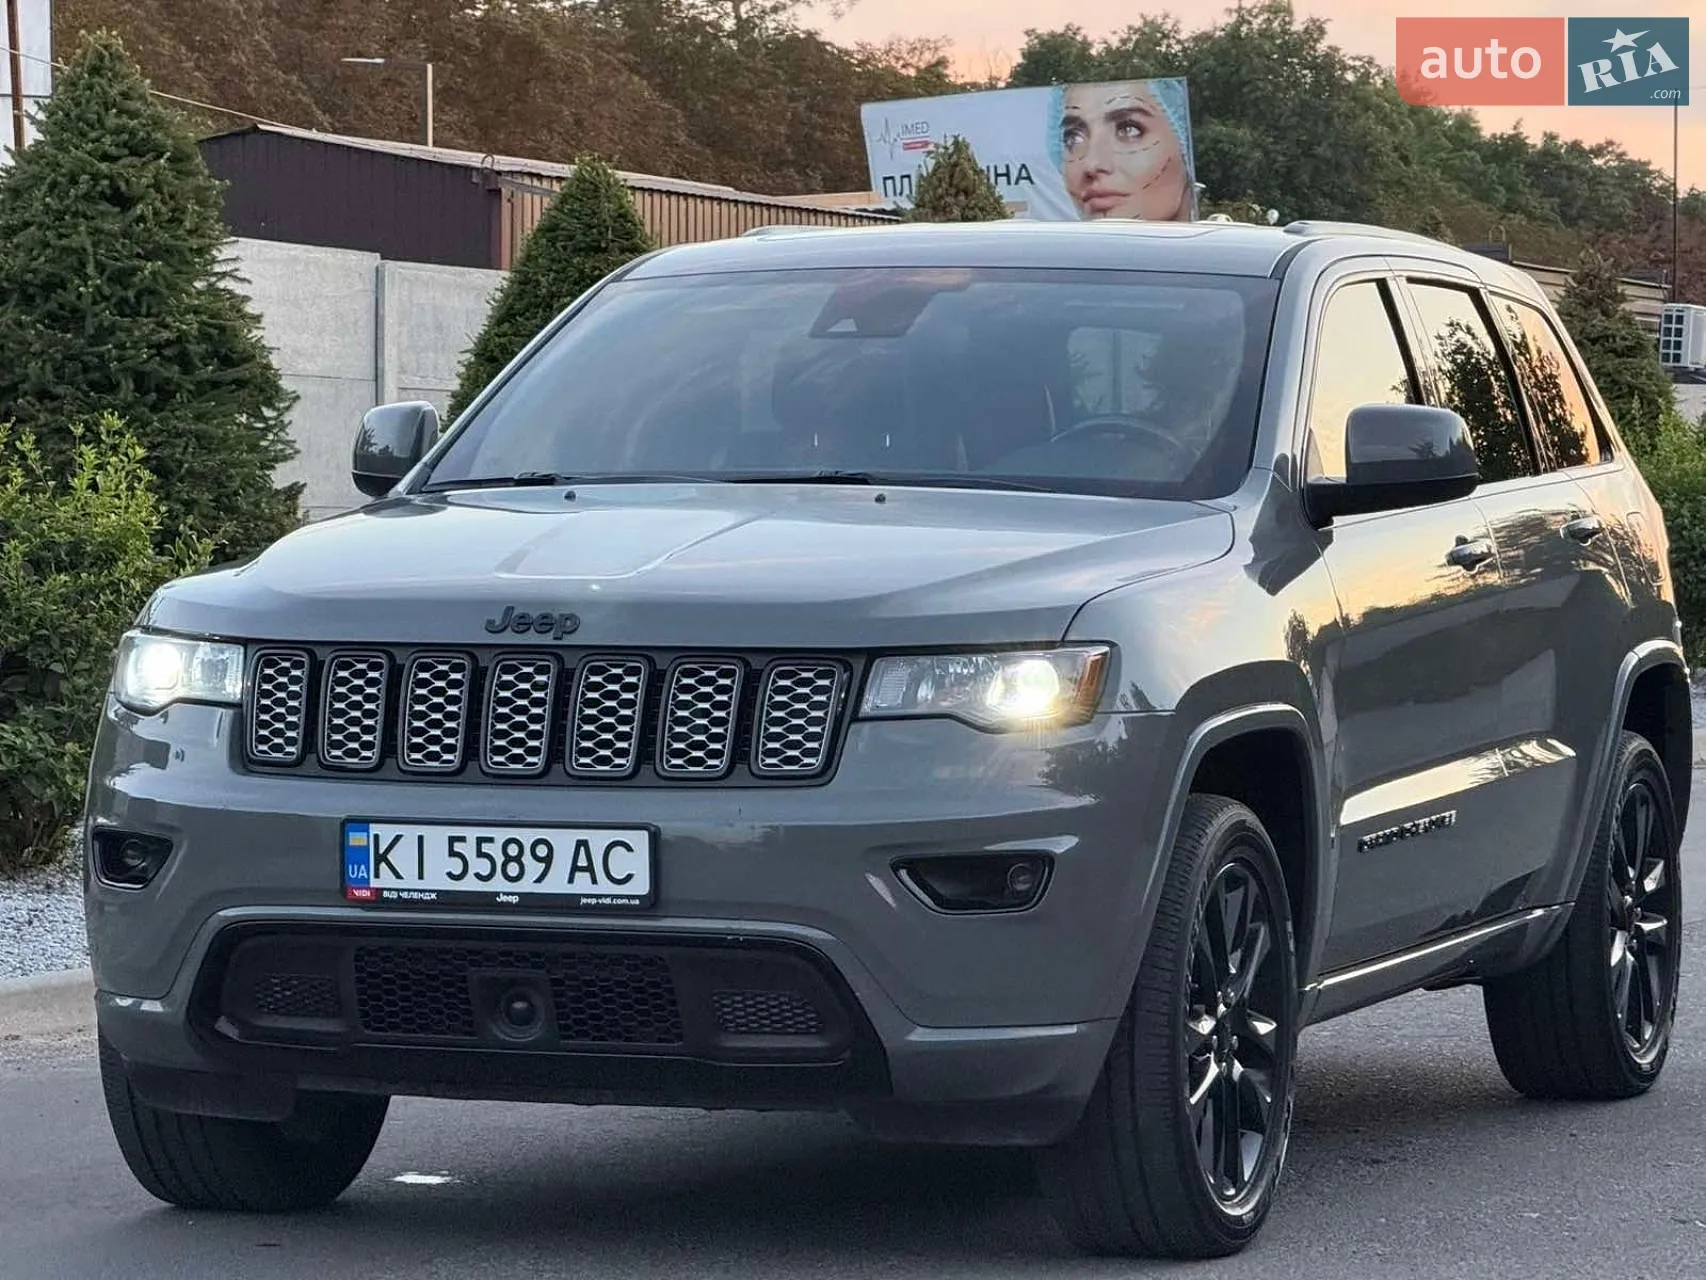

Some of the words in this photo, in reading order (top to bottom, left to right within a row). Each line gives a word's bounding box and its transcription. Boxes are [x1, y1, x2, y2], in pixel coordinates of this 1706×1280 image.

[484, 605, 581, 640] Jeep
[372, 832, 425, 881] KI
[445, 835, 554, 884] 5589
[567, 838, 635, 886] AC
[349, 864, 369, 880] UA
[496, 893, 519, 904] Jeep
